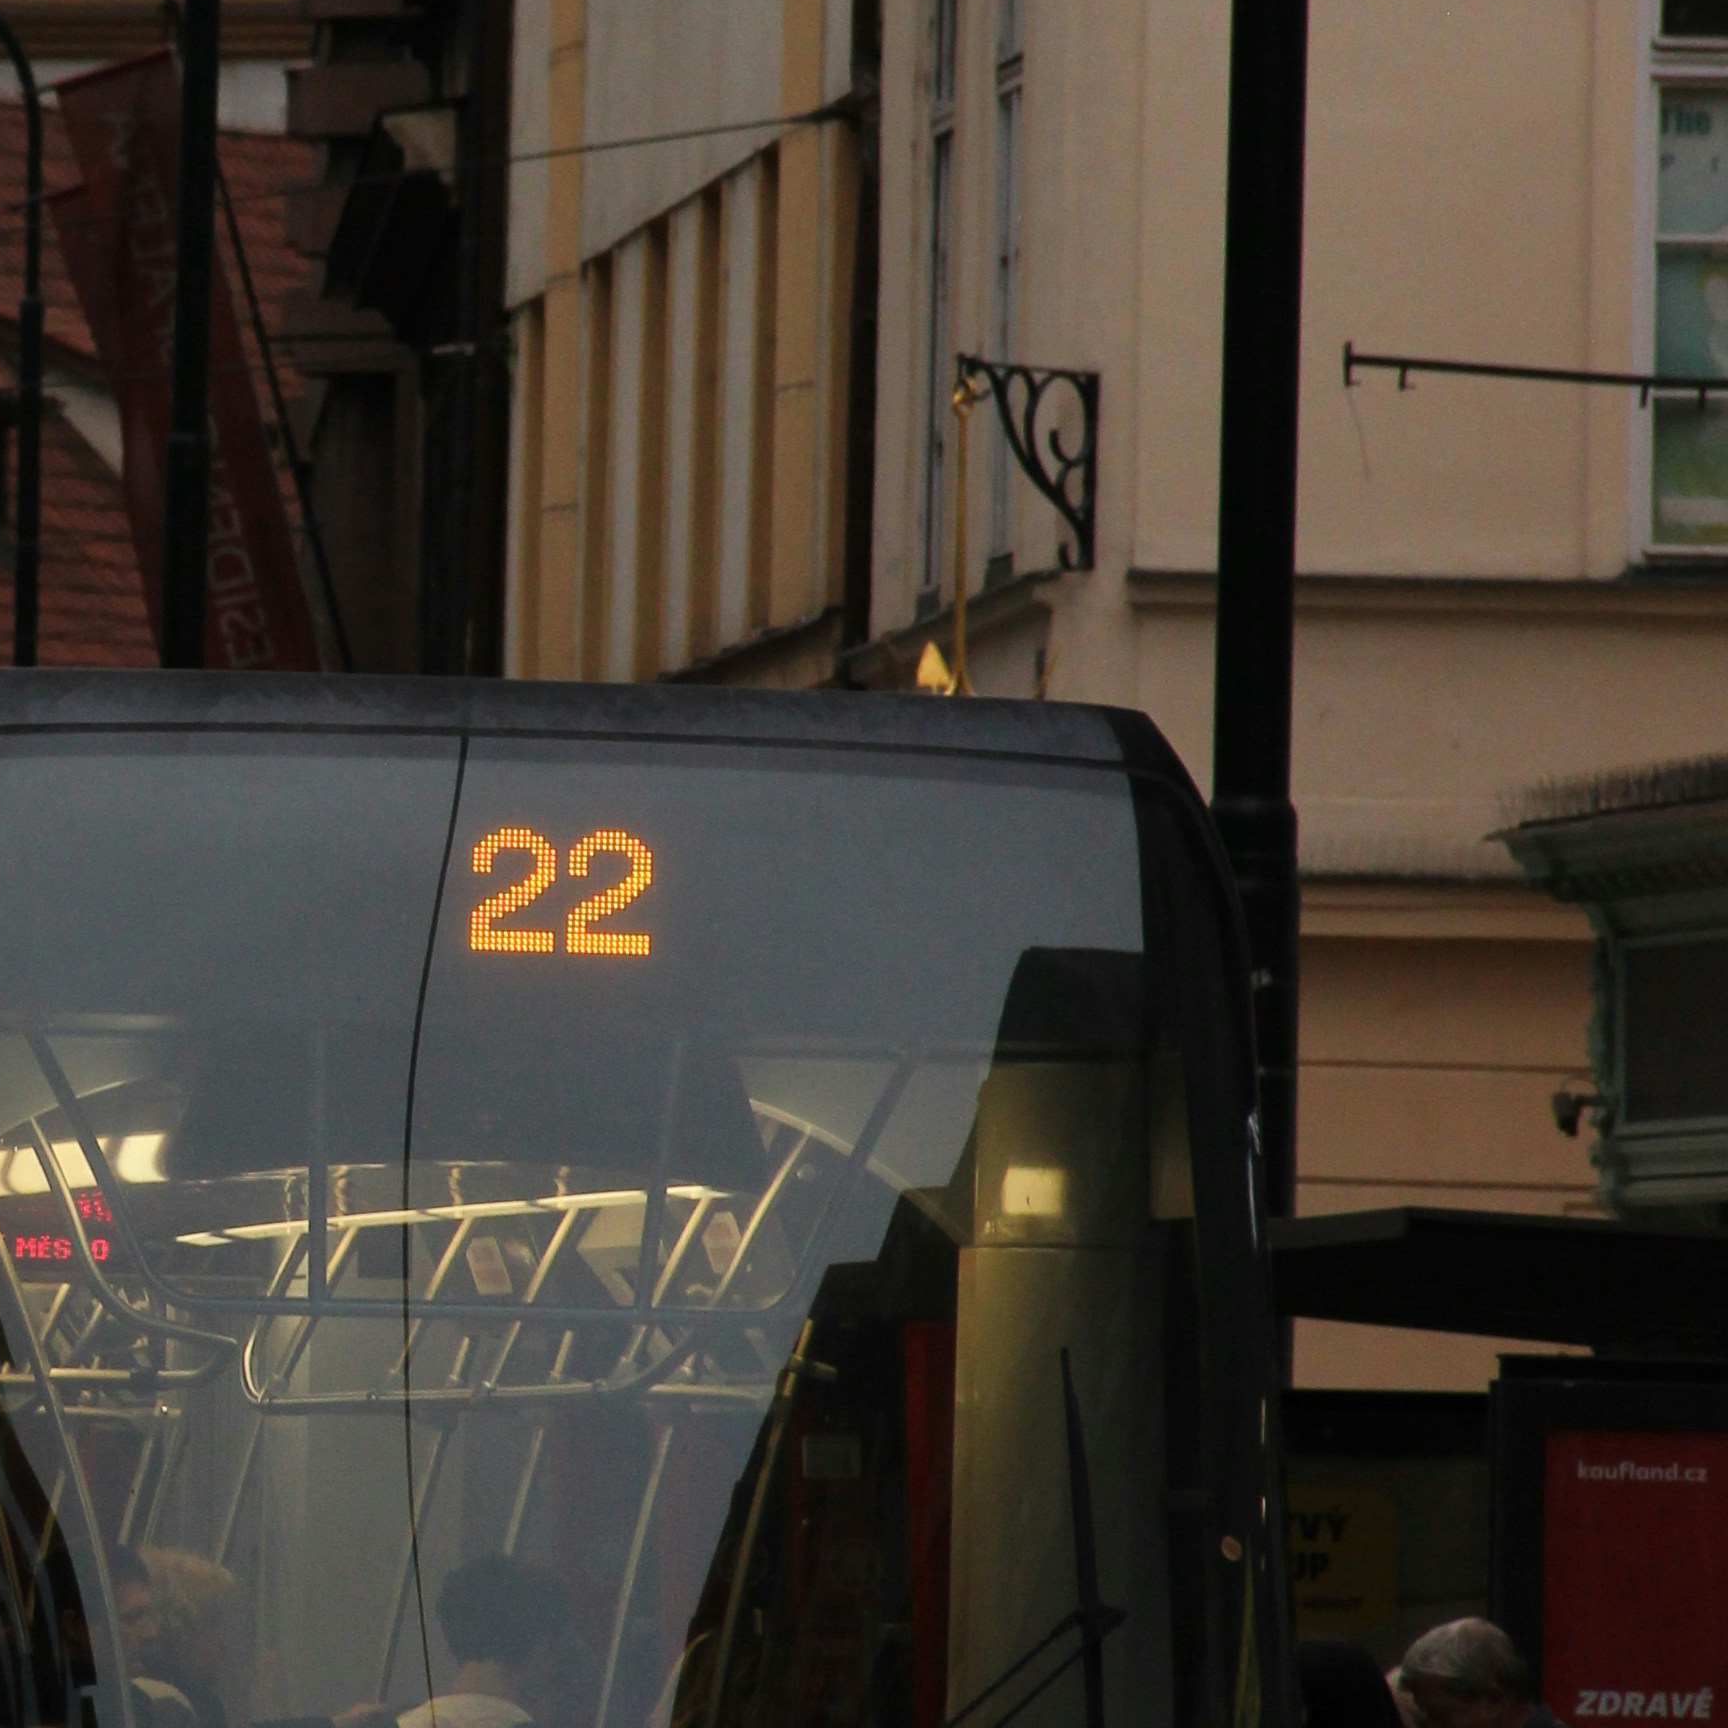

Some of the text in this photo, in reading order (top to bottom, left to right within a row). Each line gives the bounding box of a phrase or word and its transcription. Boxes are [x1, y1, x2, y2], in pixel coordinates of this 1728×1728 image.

[470, 827, 653, 956] 22
[15, 1233, 110, 1262] MĚSO
[1576, 1458, 1709, 1484] kaufland.cz
[1575, 1687, 1713, 1719] ZDRAVÉ
